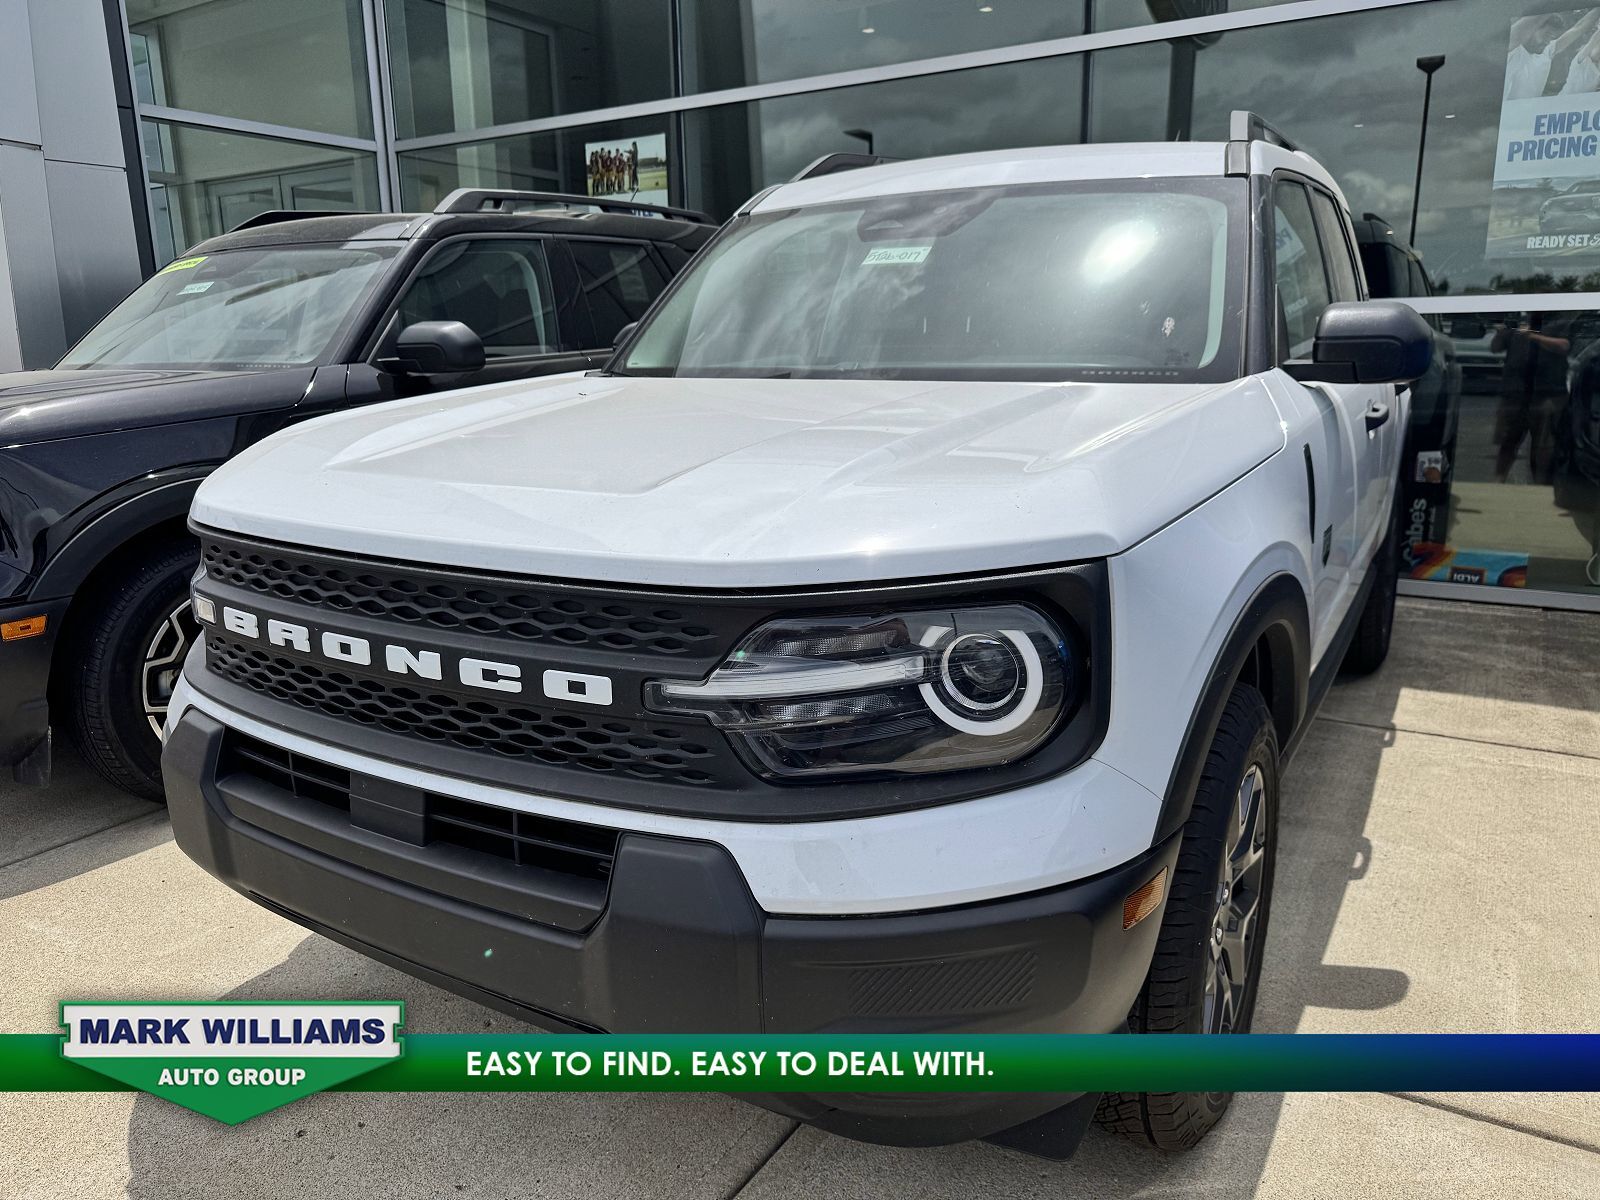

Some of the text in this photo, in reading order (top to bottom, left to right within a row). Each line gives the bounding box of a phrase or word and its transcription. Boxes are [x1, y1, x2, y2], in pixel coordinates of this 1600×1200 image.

[1507, 135, 1598, 162] PRICING
[1527, 235, 1567, 249] READY
[1567, 234, 1590, 247] SET
[1453, 572, 1480, 584] ALDI
[223, 606, 613, 706] BRONCO
